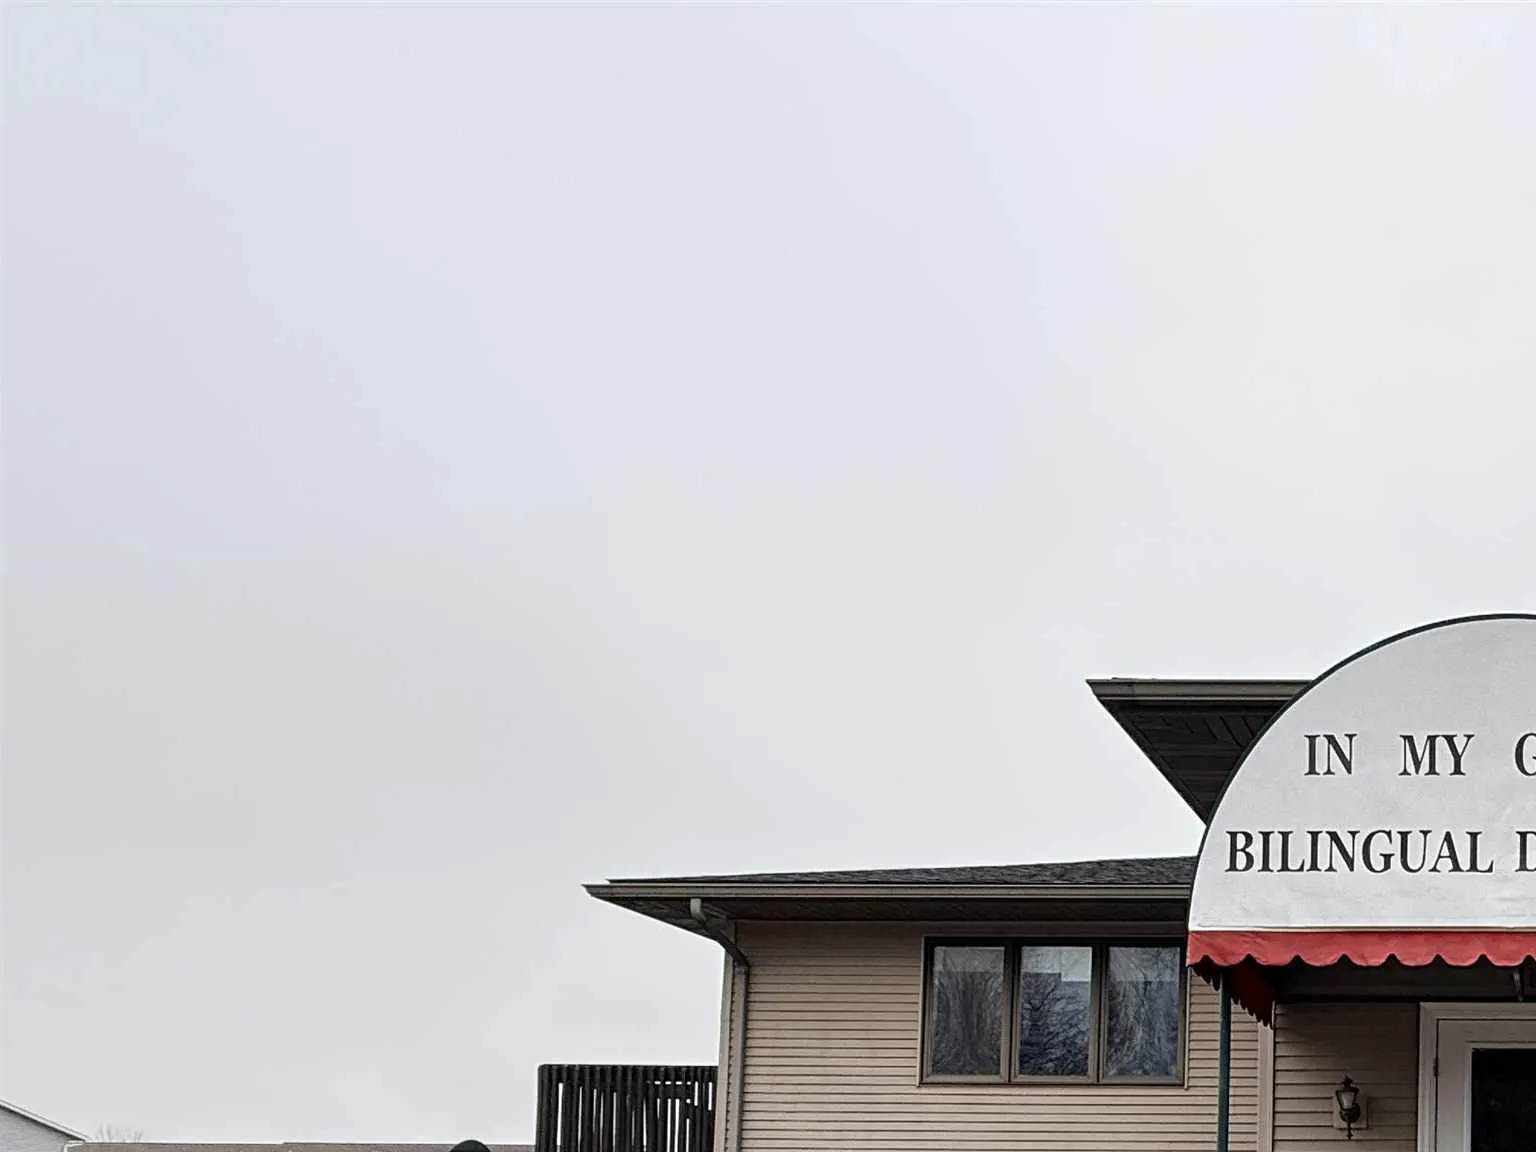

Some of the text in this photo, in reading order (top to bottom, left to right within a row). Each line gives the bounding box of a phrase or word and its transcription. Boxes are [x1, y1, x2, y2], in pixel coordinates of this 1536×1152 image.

[1304, 733, 1357, 776] IN
[1398, 733, 1475, 776] MY
[1225, 829, 1494, 873] BILINGUAL
